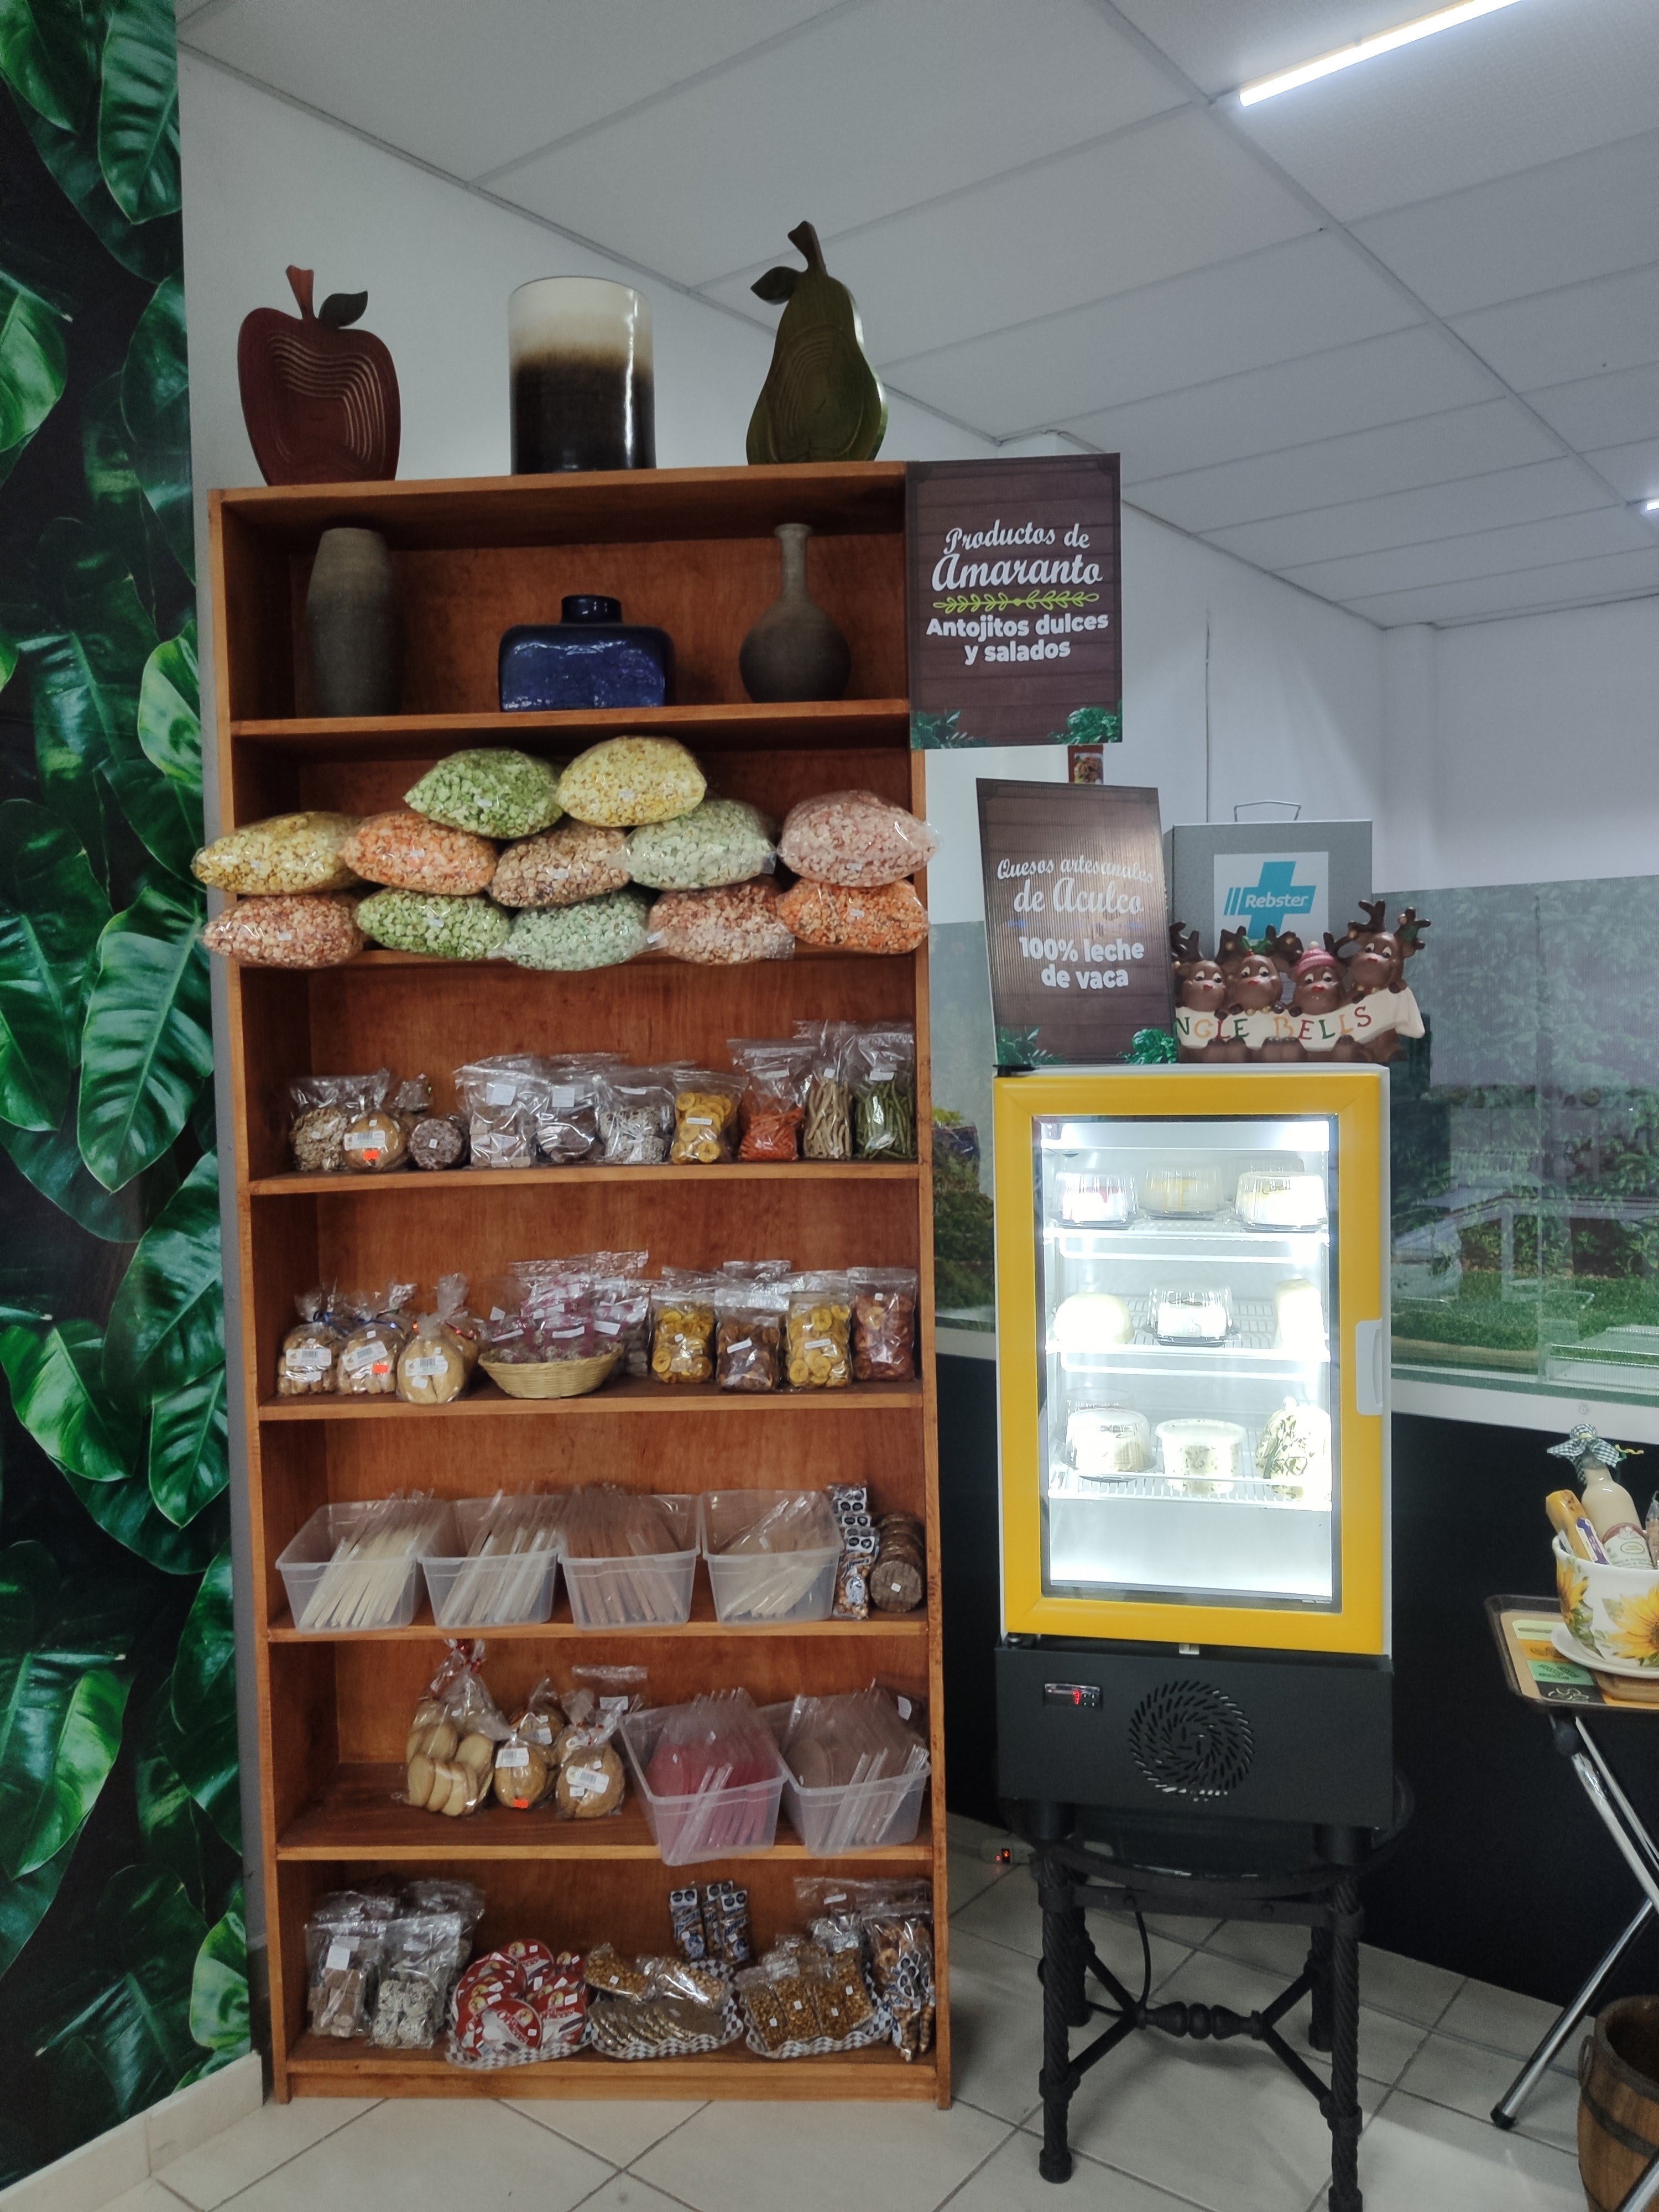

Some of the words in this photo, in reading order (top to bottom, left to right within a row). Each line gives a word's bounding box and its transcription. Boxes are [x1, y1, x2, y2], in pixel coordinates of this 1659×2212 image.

[943, 519, 1055, 554] Productos
[1063, 523, 1091, 549] de
[931, 552, 1103, 591] Amaranto
[926, 614, 1030, 642] Antojitos
[1035, 613, 1109, 636] dulces
[964, 644, 979, 665] y
[984, 639, 1071, 662] salados
[997, 858, 1055, 880] Quesos
[1060, 854, 1154, 883] artesanales
[1014, 878, 1045, 912] de
[1052, 877, 1144, 915] Aculco
[1245, 891, 1309, 909] Rebster
[1019, 936, 1079, 963] 100%
[1084, 938, 1145, 963] leche
[1041, 964, 1071, 988] de
[1075, 968, 1129, 990] vaca
[1273, 1005, 1373, 1041] BELLS
